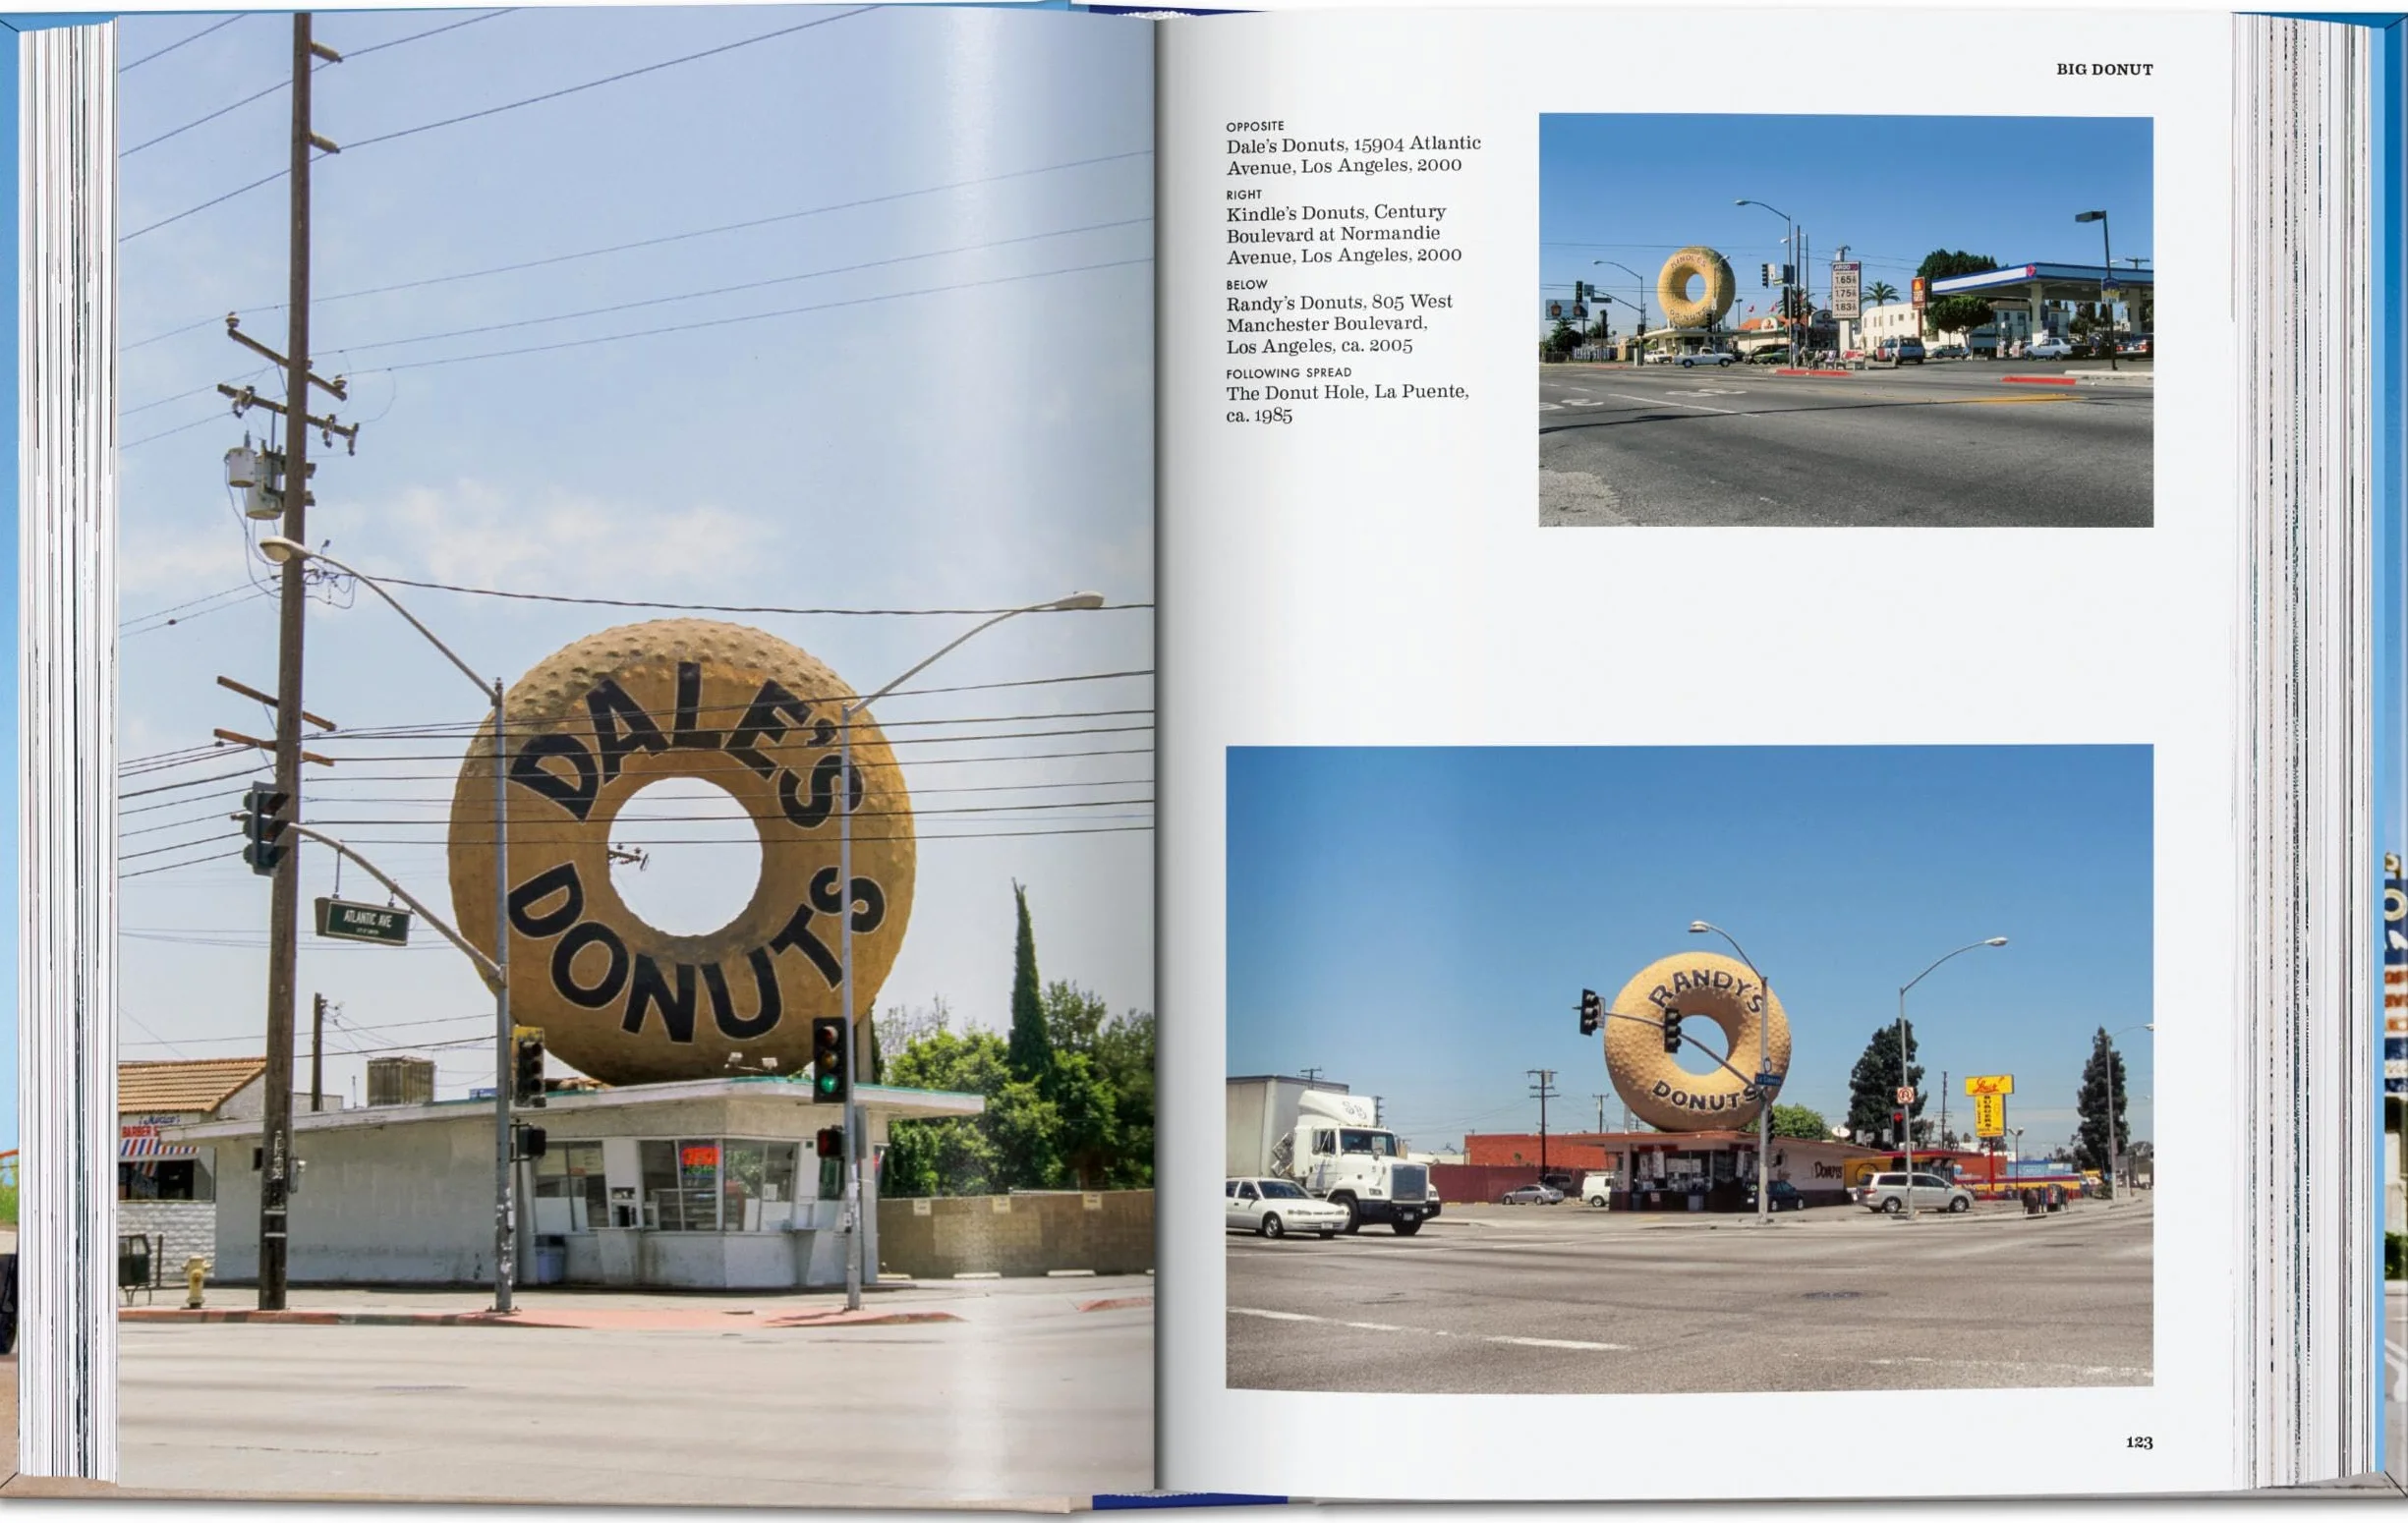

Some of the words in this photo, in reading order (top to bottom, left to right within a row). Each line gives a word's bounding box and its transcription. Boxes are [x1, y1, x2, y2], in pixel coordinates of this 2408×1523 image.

[2057, 63, 2088, 76] BIG
[2092, 63, 2153, 76] DONUT
[1225, 120, 1285, 133] OPPOSITE
[1226, 138, 1277, 154] Dale's
[1281, 137, 1348, 153] Donuts,
[1353, 138, 1405, 153] 15904
[1408, 135, 1481, 150] Atlantic
[1226, 160, 1296, 176] Avenue,
[1300, 158, 1332, 173] Los
[1336, 157, 1412, 176] Angeles,
[1416, 158, 1462, 171] 2000
[1226, 189, 1262, 200] RIGHT
[1226, 205, 1296, 222] Kindle's
[1300, 204, 1368, 220] Donuts,
[1374, 202, 1447, 221] Century
[1226, 226, 1314, 244] Boulevard
[1319, 227, 1336, 242] at
[1340, 224, 1440, 241] Normandie
[1226, 250, 1296, 265] Avenue,
[1300, 248, 1332, 262] Los
[1336, 247, 1412, 265] Angeles,
[1416, 248, 1462, 261] 2000
[1226, 278, 1268, 291] BELOW
[1226, 295, 1294, 313] Randy's
[1299, 295, 1367, 310] Donuts,
[1371, 293, 1404, 310] 805
[1408, 293, 1453, 309] West
[1226, 316, 1329, 332] Manchester
[1333, 314, 1427, 331] Boulevard,
[1226, 339, 1256, 354] Los
[1260, 337, 1336, 357] Angeles,
[1341, 340, 1364, 352] ca.
[1369, 338, 1412, 354] 2005
[1226, 367, 1299, 379] FOLLOWING
[1305, 367, 1351, 377] SPREAD
[1226, 385, 1259, 401] The
[1264, 384, 1319, 400] Donut
[1323, 383, 1368, 401] Hole,
[1374, 383, 1397, 399] La
[1401, 383, 1468, 400] Puente,
[1226, 411, 1249, 423] ca.
[1254, 406, 1292, 424] 1985
[507, 660, 865, 830] DALE'S
[343, 909, 376, 926] ATLANTIC
[377, 914, 392, 929] AVE
[506, 862, 887, 1044] DONUTS
[1648, 969, 1763, 1014] RANDY'S
[1652, 1079, 1760, 1111] DONUTS
[2127, 1436, 2153, 1450] 123
